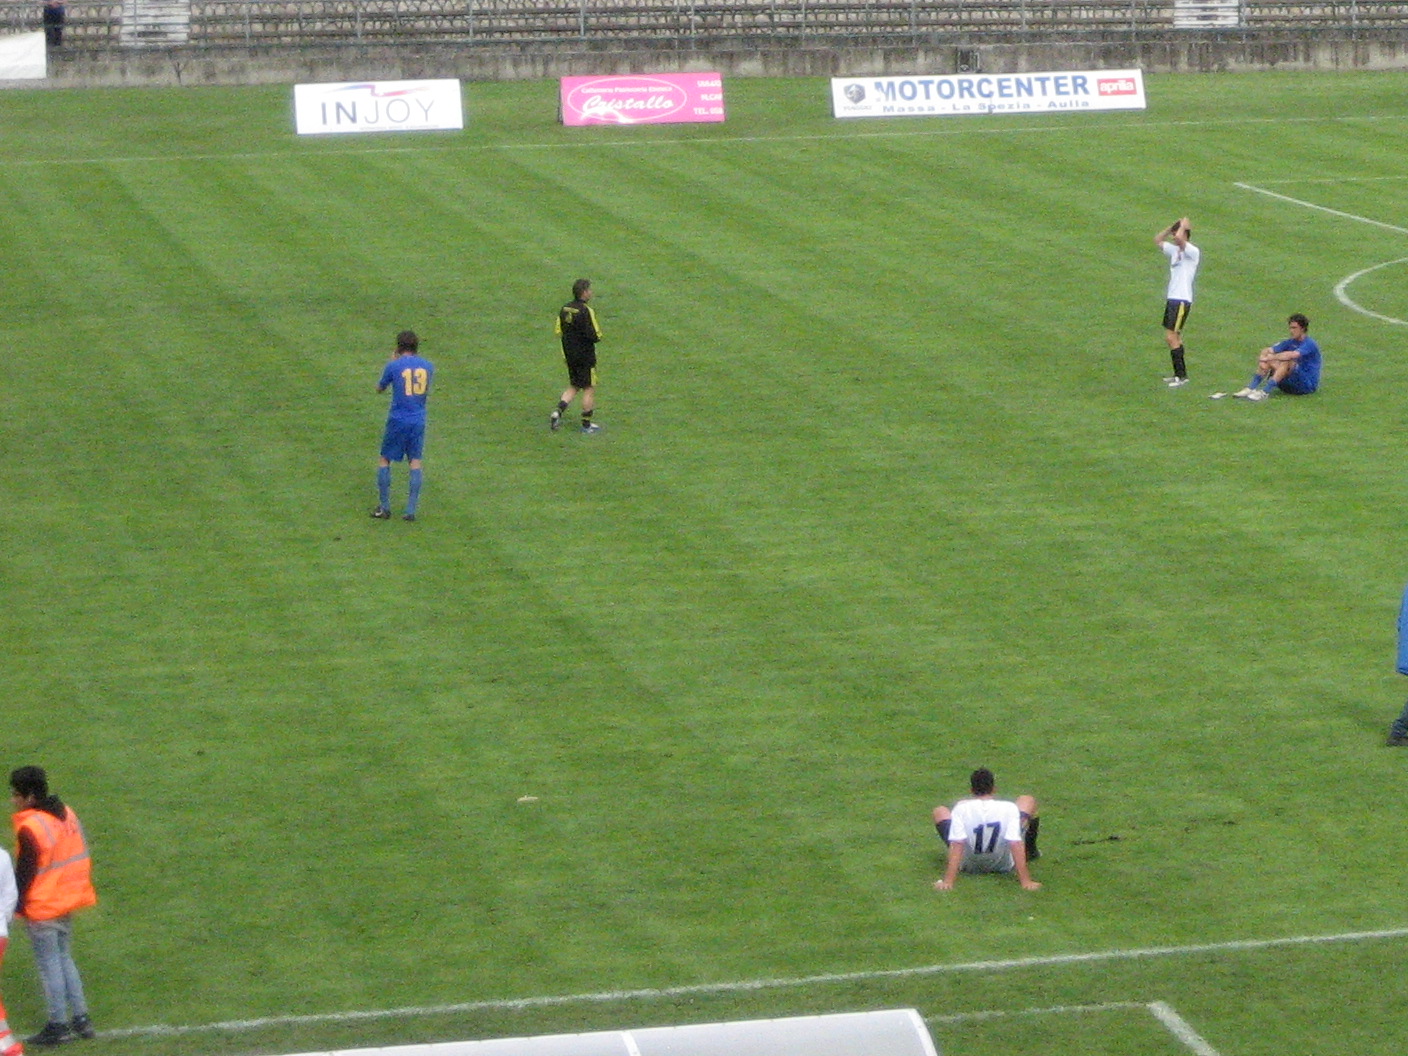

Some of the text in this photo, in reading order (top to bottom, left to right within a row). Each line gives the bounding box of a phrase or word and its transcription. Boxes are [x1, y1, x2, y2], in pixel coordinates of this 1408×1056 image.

[874, 75, 1090, 102] MOTORCENTER
[1100, 79, 1134, 93] aprilia
[321, 98, 434, 125] INJOY
[582, 95, 675, 113] Cristallo
[883, 100, 1090, 113] Massa La Spezia Aulla
[402, 368, 428, 396] 13
[973, 821, 1002, 855] 17
